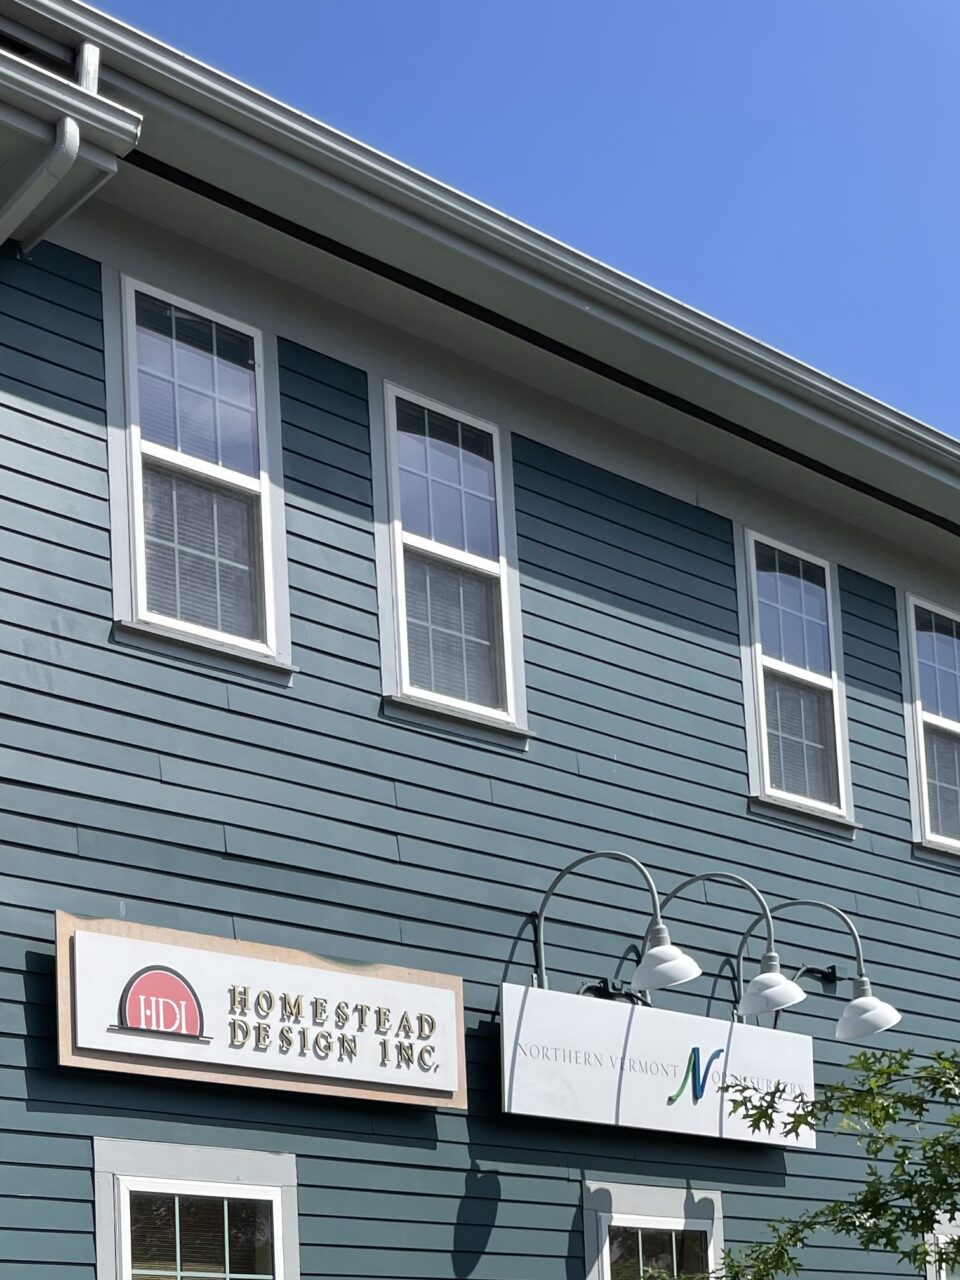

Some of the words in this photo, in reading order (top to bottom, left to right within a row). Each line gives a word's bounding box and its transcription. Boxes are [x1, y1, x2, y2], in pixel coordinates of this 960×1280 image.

[138, 995, 187, 1034] HDI
[229, 984, 437, 1038] HOMESTEAD
[230, 1018, 358, 1060] DESIGN
[516, 1042, 603, 1067] NORTHERN
[609, 1055, 680, 1078] VERMONT
[749, 1075, 806, 1097] SURRY
